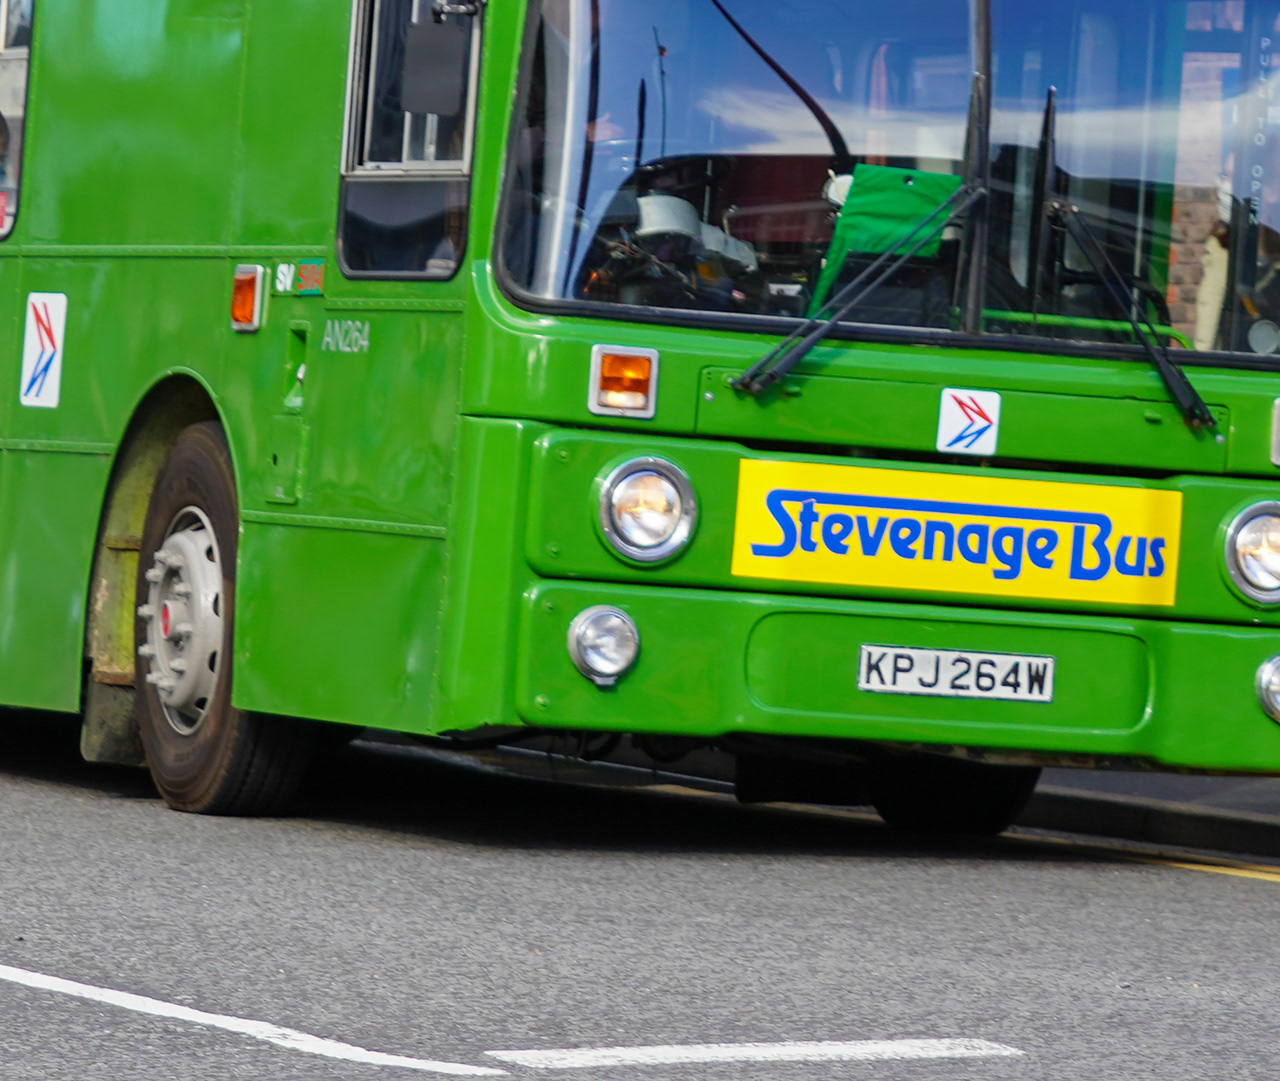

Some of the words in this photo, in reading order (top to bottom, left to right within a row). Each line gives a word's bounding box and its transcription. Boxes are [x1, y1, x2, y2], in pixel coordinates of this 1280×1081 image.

[321, 320, 370, 353] AN264
[751, 489, 1058, 580] Stevenage
[1069, 514, 1166, 581] Bus
